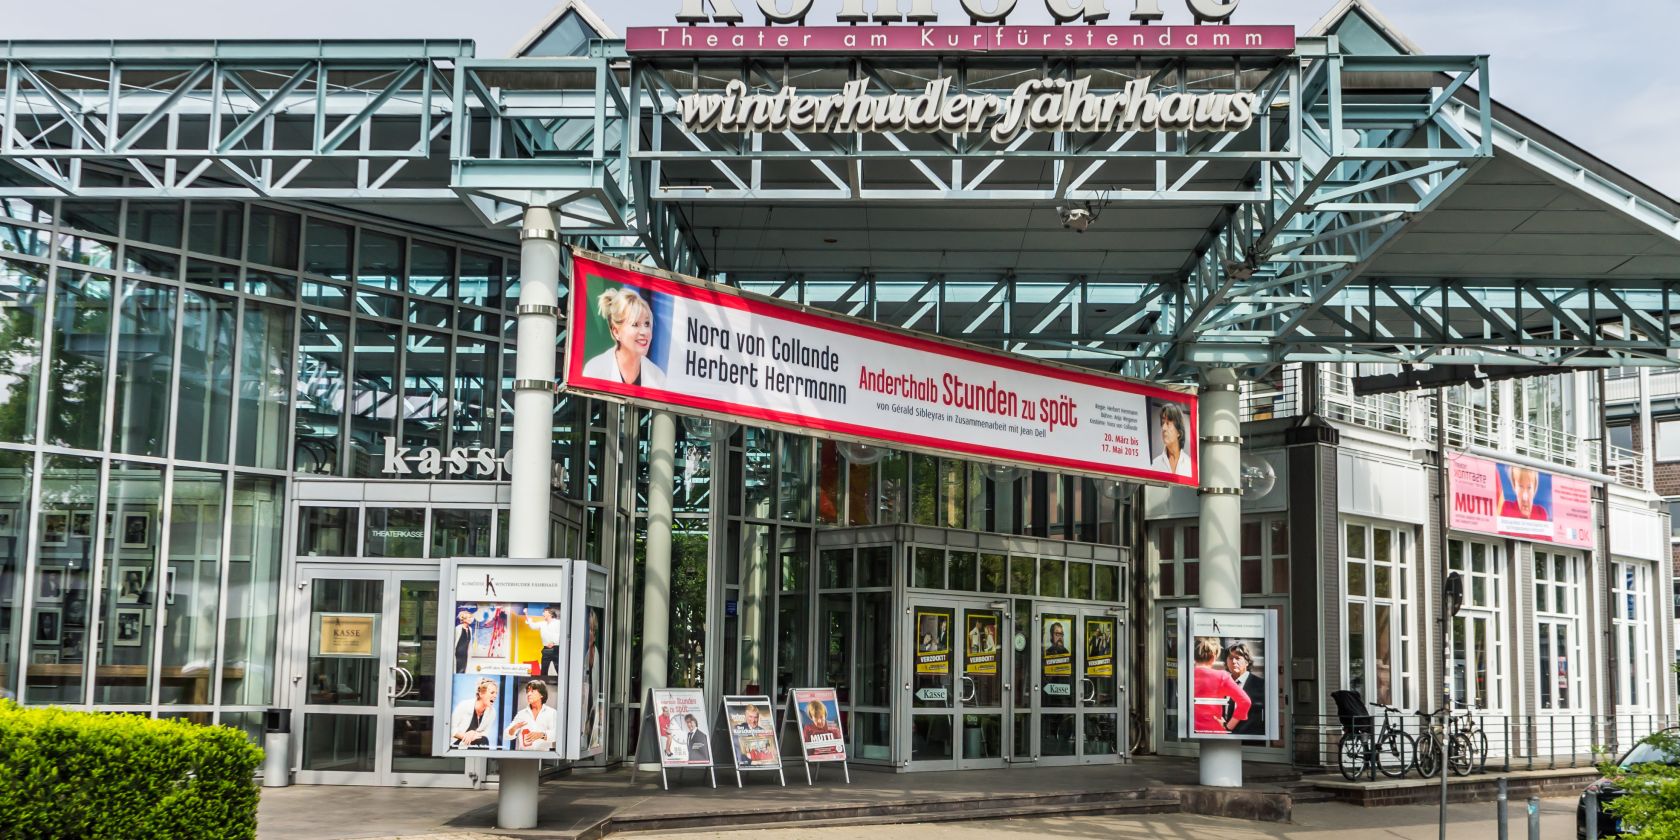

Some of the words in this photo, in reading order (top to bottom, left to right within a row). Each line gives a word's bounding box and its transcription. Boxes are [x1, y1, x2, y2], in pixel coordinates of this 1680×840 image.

[658, 28, 812, 47] Theater
[843, 32, 888, 47] am
[920, 27, 1263, 47] Kurfürstendamm
[677, 76, 998, 134] winterhuder
[989, 75, 1256, 144] fährhaus
[687, 317, 730, 351] Nora
[736, 332, 766, 358] von
[771, 335, 839, 373] Collande
[685, 350, 759, 388] Herbert
[764, 366, 847, 405] Herrmann
[858, 365, 938, 404] Anderthalb
[942, 372, 1018, 418] Stunden
[1021, 399, 1036, 421] zu
[1039, 394, 1078, 433] spät
[876, 402, 890, 411] von
[891, 402, 914, 416] Gérald
[915, 407, 945, 421] Sibleyras
[946, 412, 953, 422] in
[954, 414, 1007, 432] Zusammenarbeit
[1008, 423, 1019, 434] mit
[1019, 425, 1034, 436] Jean
[1034, 427, 1047, 438] Dell
[1104, 432, 1114, 443] 20.
[1115, 435, 1129, 444] März
[1130, 436, 1139, 446] bis
[1102, 444, 1111, 453] 17.
[1112, 446, 1123, 455] Mai
[1125, 447, 1139, 457] 2015
[1455, 492, 1494, 516] MUTTI
[372, 530, 424, 538] THEATERKASSE
[333, 629, 360, 637] KASSE
[923, 689, 946, 699] Kasse
[1050, 684, 1069, 694] Kasse
[810, 732, 834, 743] MUTTI
